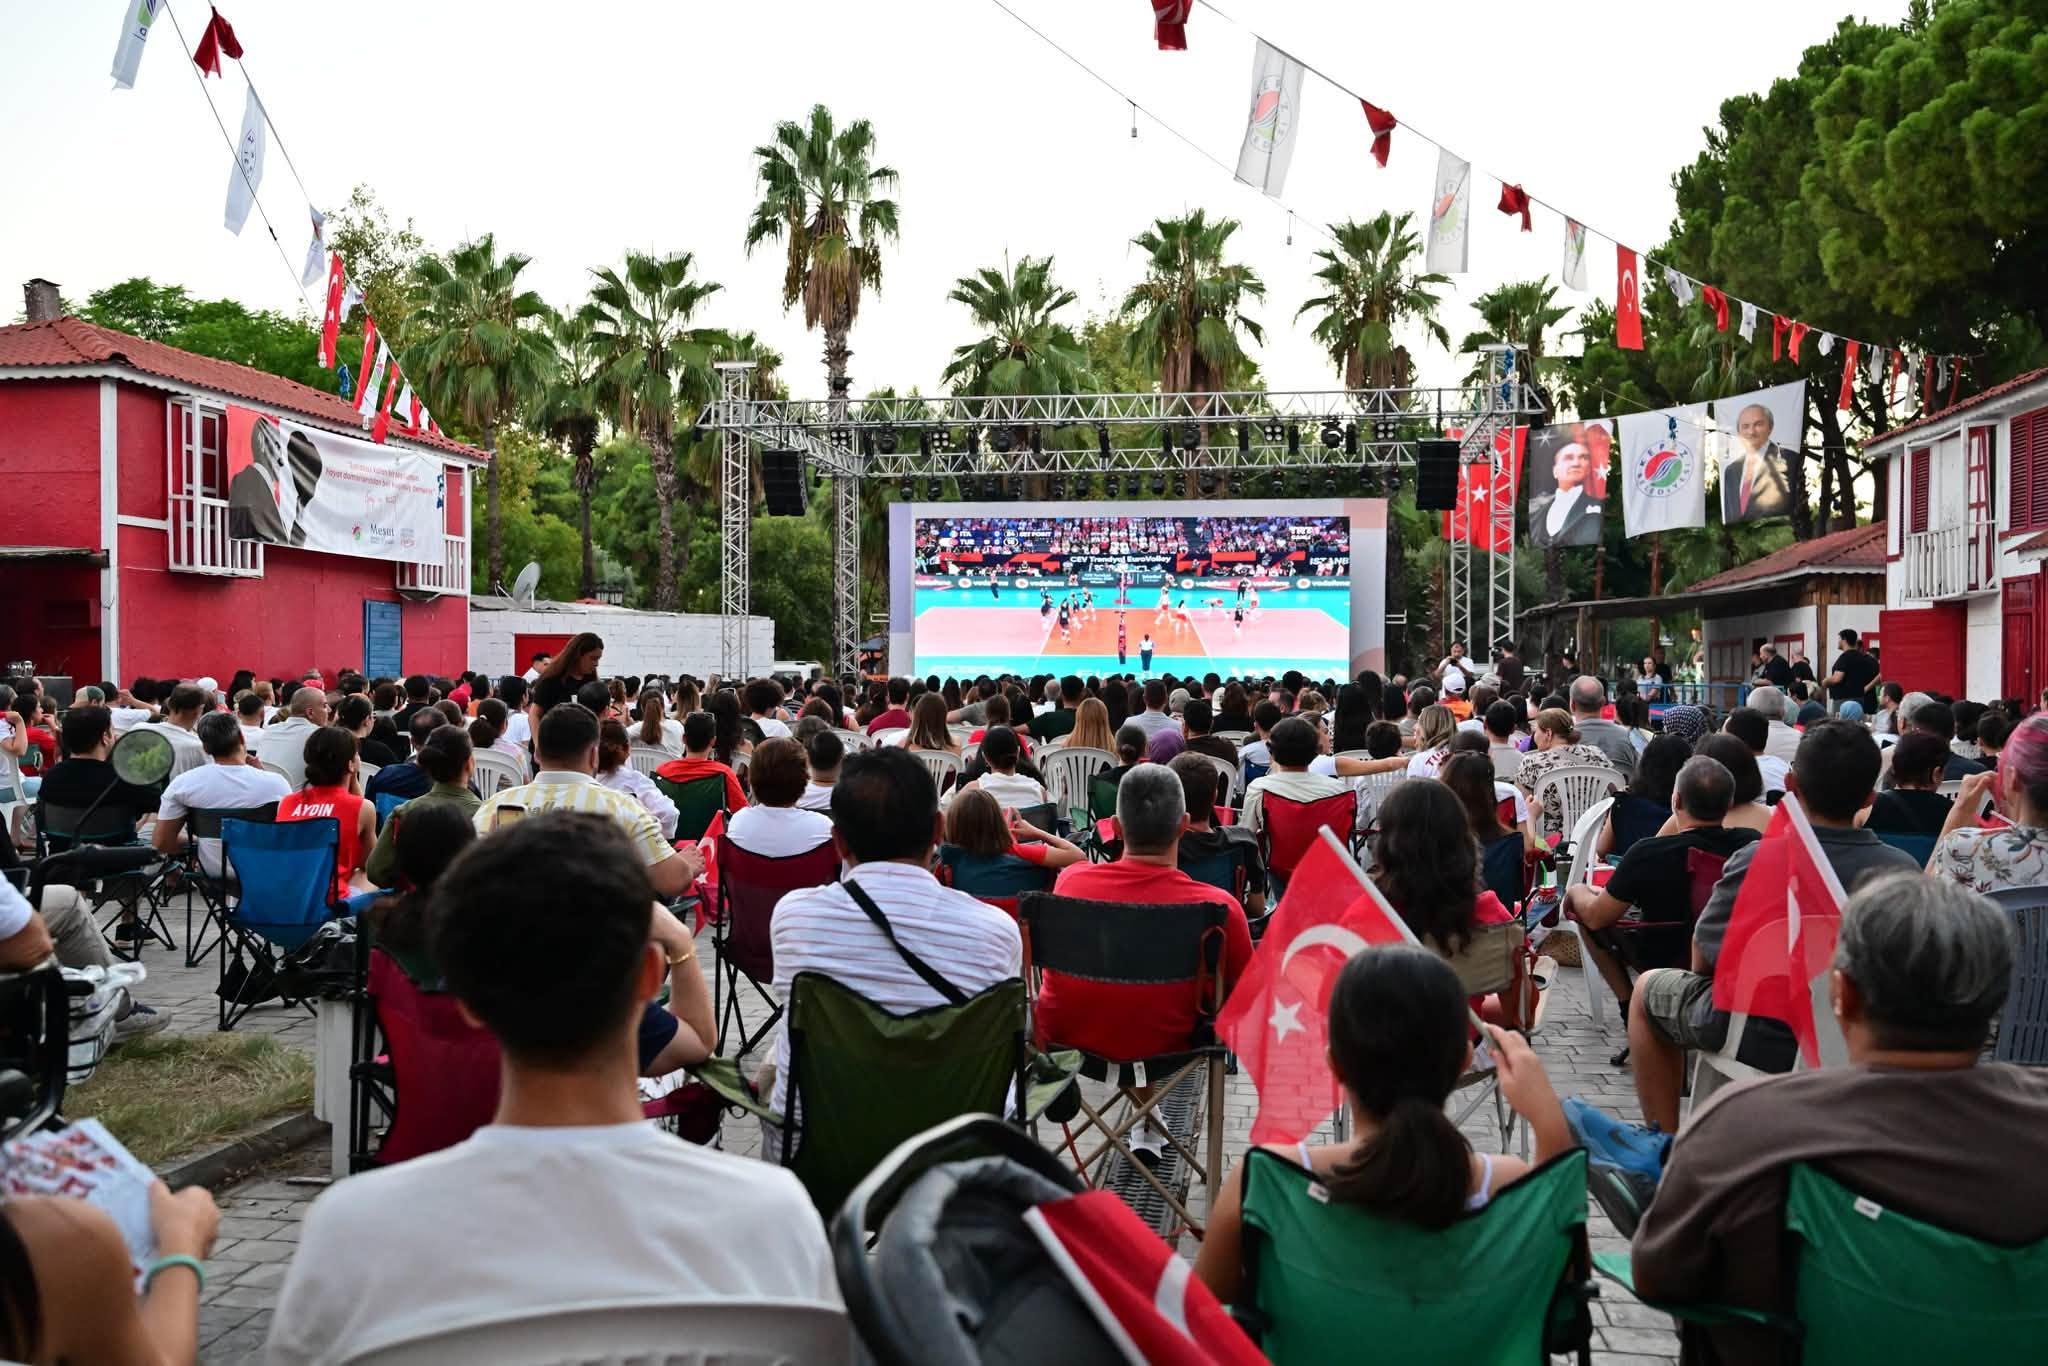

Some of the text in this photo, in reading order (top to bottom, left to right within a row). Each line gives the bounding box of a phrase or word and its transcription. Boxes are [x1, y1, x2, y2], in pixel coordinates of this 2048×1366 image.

[370, 523, 395, 537] Mesut
[1127, 556, 1171, 564] EuroVolley
[291, 803, 335, 817] AYDIN
